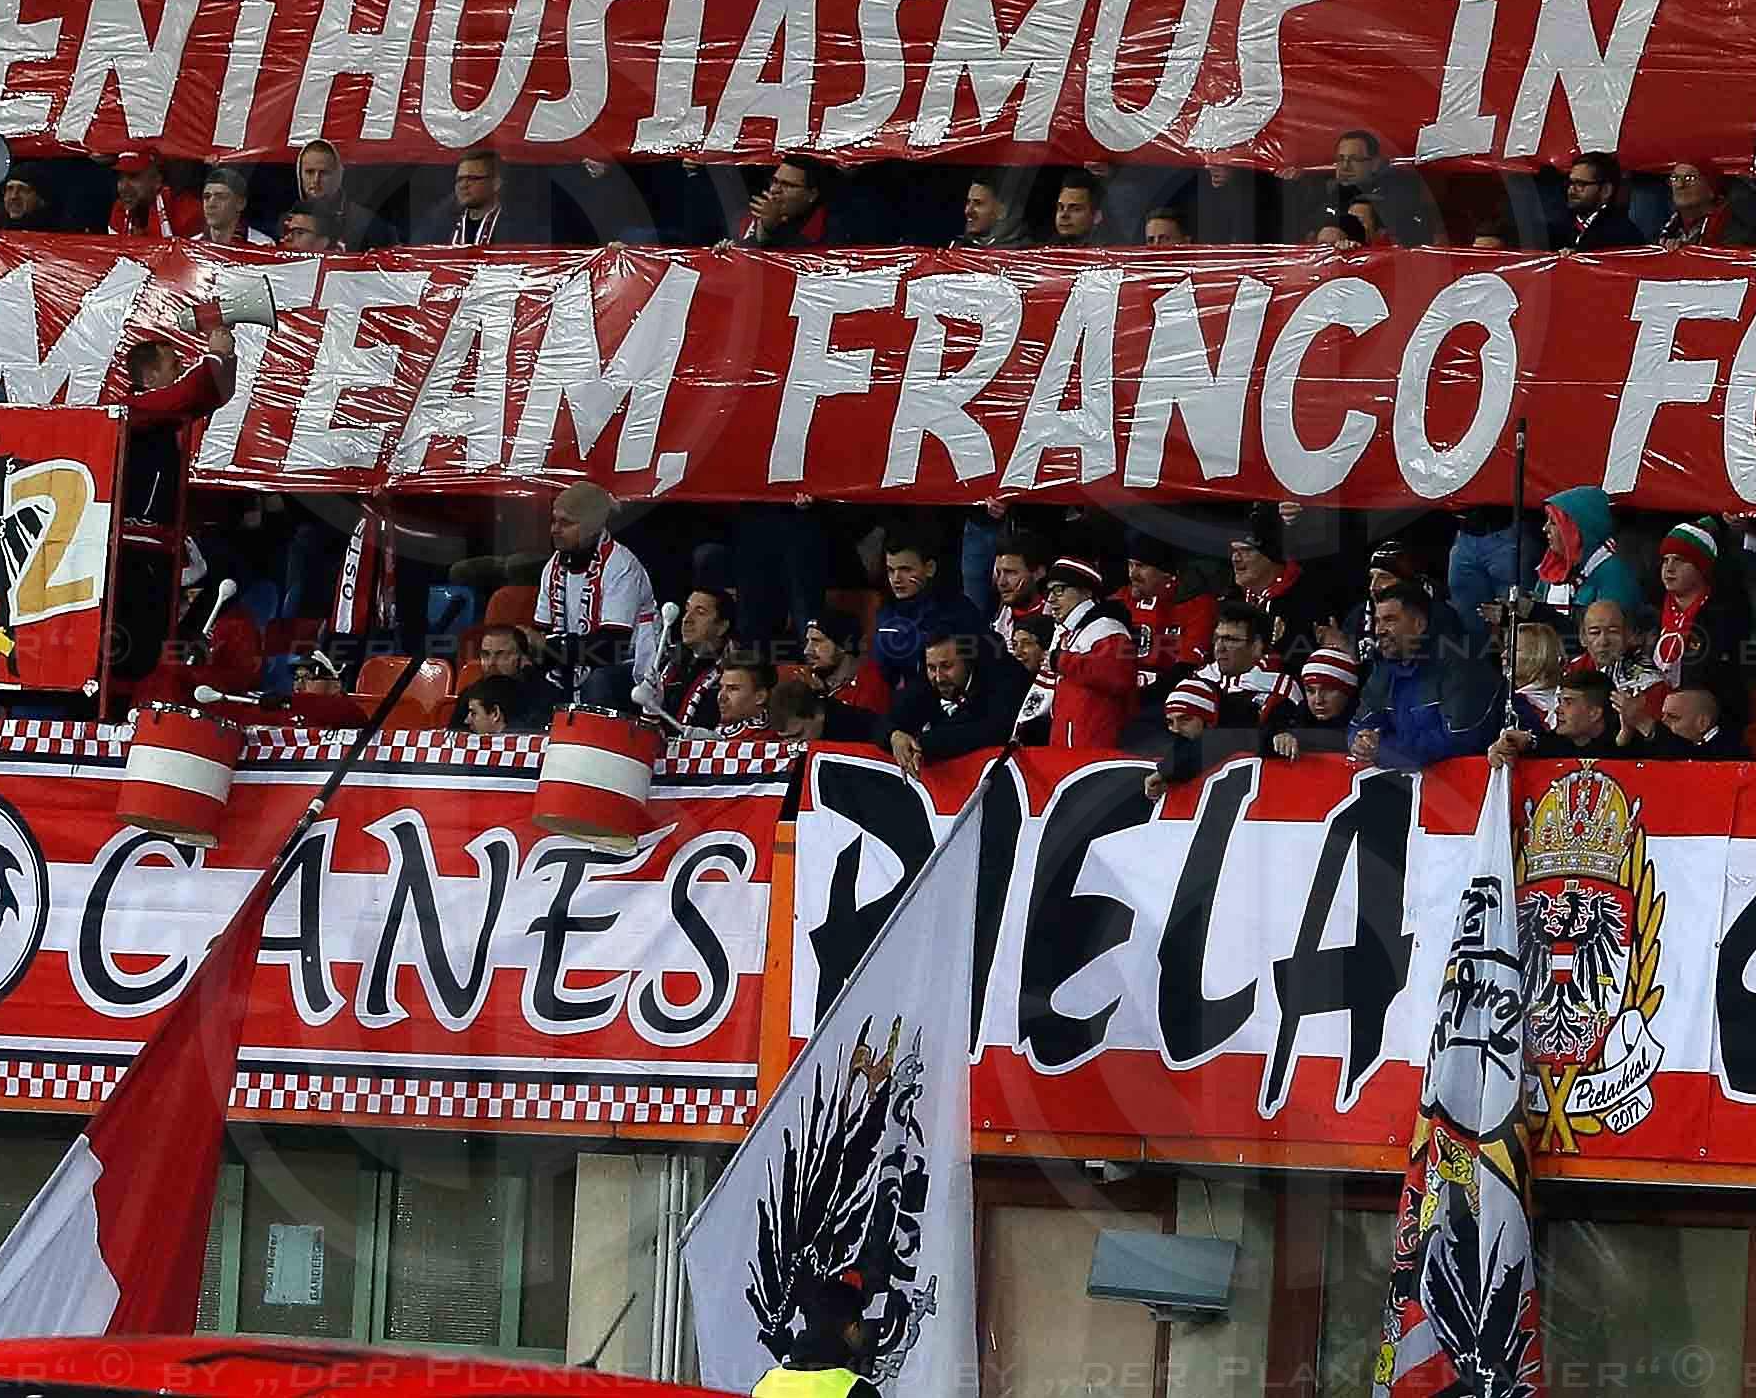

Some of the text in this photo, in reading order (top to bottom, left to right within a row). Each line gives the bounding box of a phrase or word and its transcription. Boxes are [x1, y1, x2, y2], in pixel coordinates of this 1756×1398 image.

[193, 256, 703, 497] TEAM,
[767, 266, 1519, 499] FRANCO
[68, 808, 757, 1050] CANES
[1611, 1100, 1641, 1133] 2017
